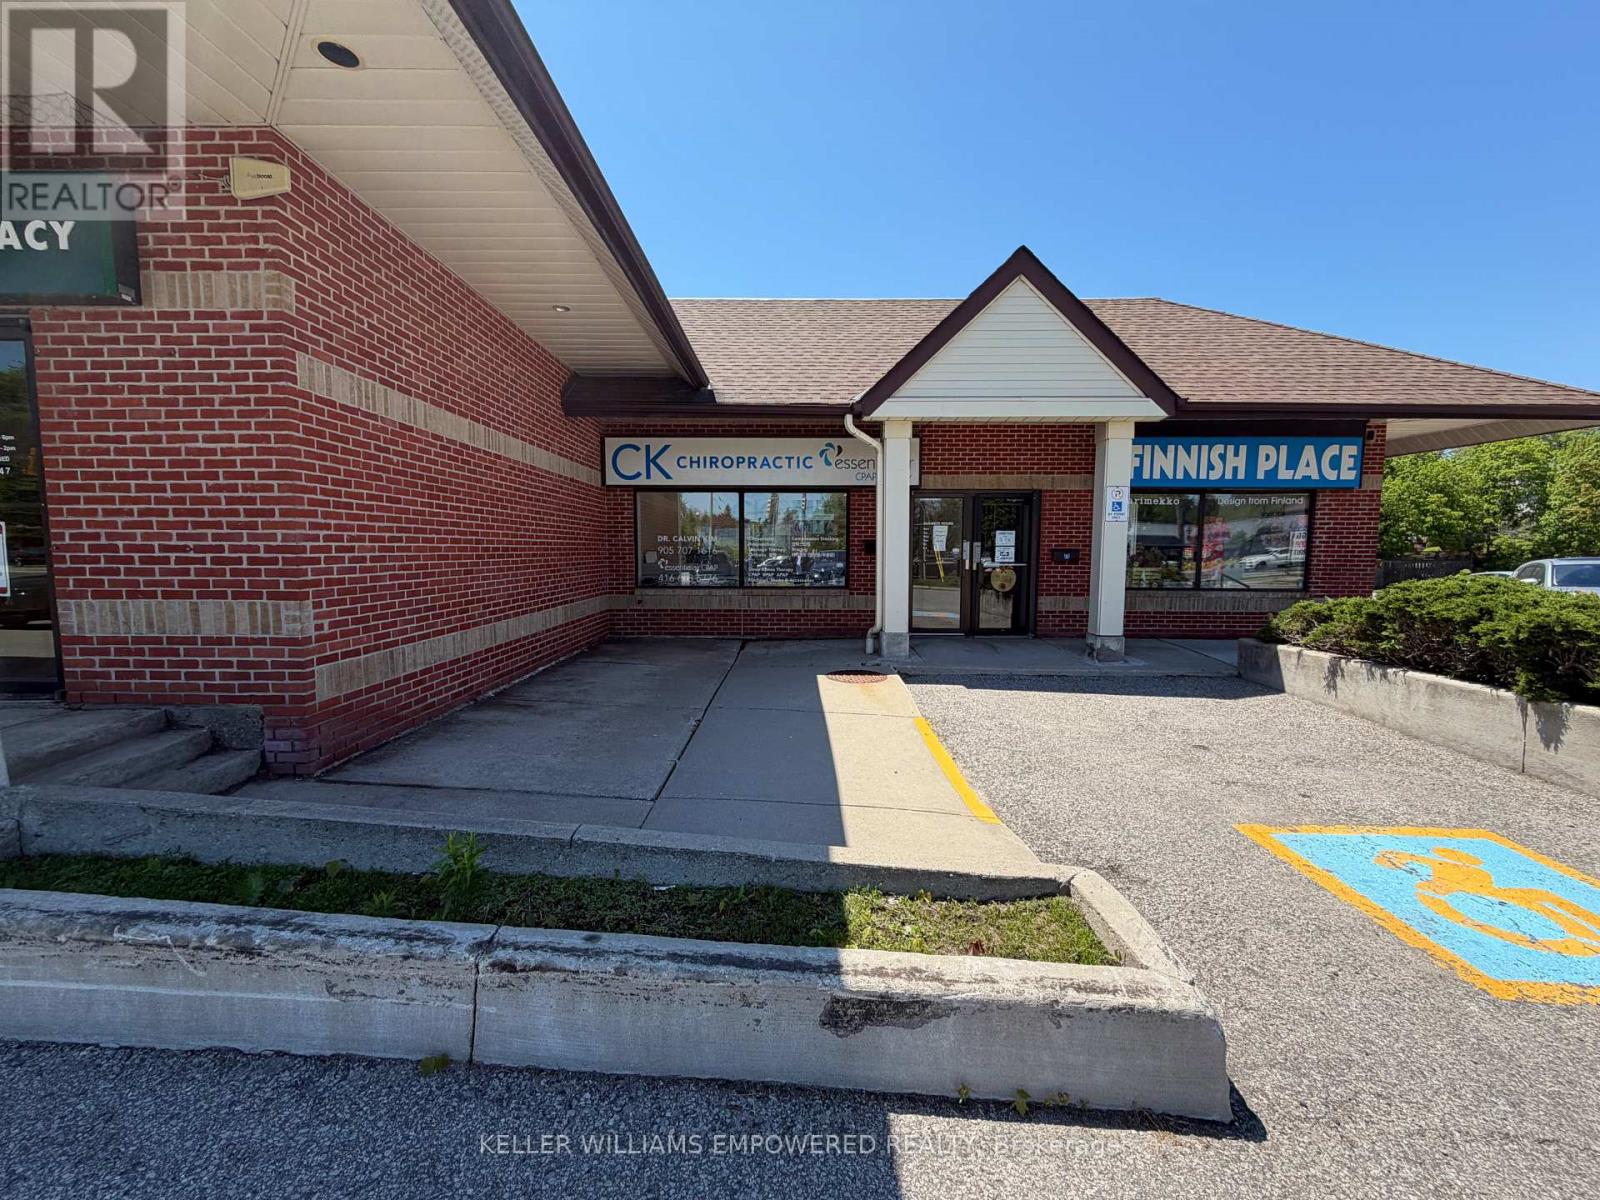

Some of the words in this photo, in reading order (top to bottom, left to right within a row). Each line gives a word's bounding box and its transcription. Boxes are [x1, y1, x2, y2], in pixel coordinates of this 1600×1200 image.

[611, 443, 673, 481] CK
[676, 455, 814, 469] CHIROPRACTIC
[1130, 444, 1248, 481] FINNISH
[1256, 444, 1358, 481] PLACE
[1130, 496, 1180, 505] rimekko
[1217, 496, 1246, 507] Design
[1248, 496, 1269, 505] from
[1270, 496, 1304, 505] Finland
[657, 546, 674, 555] 905
[677, 546, 693, 555] 707
